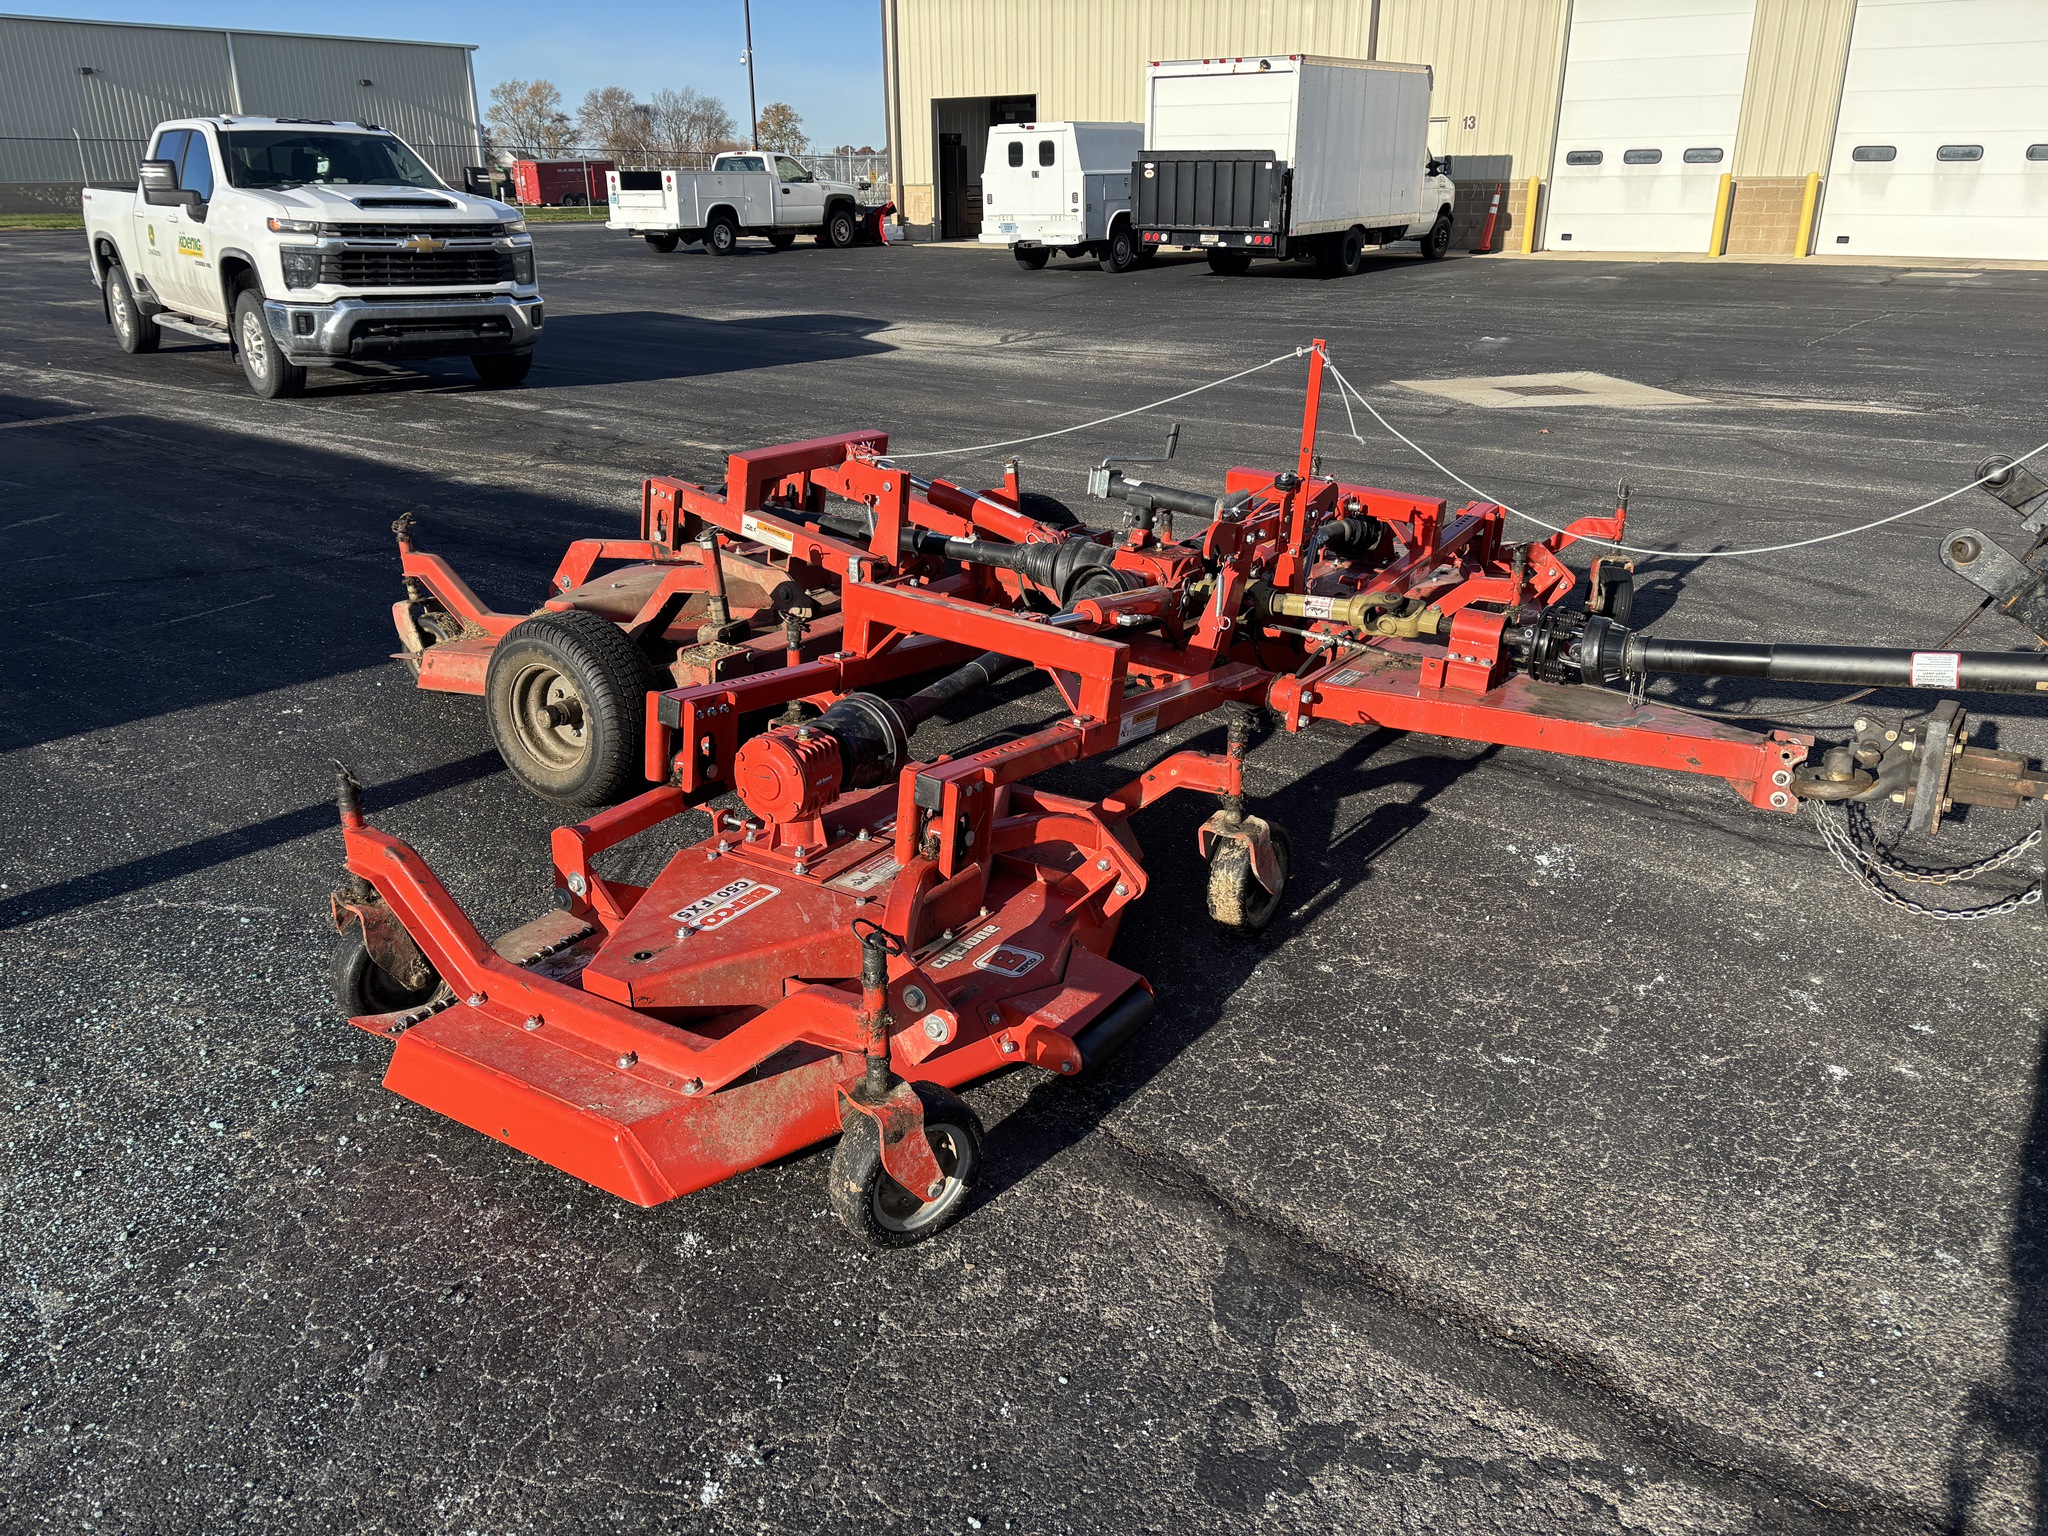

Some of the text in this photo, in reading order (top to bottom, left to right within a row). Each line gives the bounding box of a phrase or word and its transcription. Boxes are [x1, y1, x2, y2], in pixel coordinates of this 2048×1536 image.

[1463, 115, 1476, 130] 13
[676, 881, 750, 919] C50 FX5
[700, 887, 773, 926] BEFCO
[930, 925, 1003, 969] cyclone
[1015, 957, 1037, 973] BEFCO
